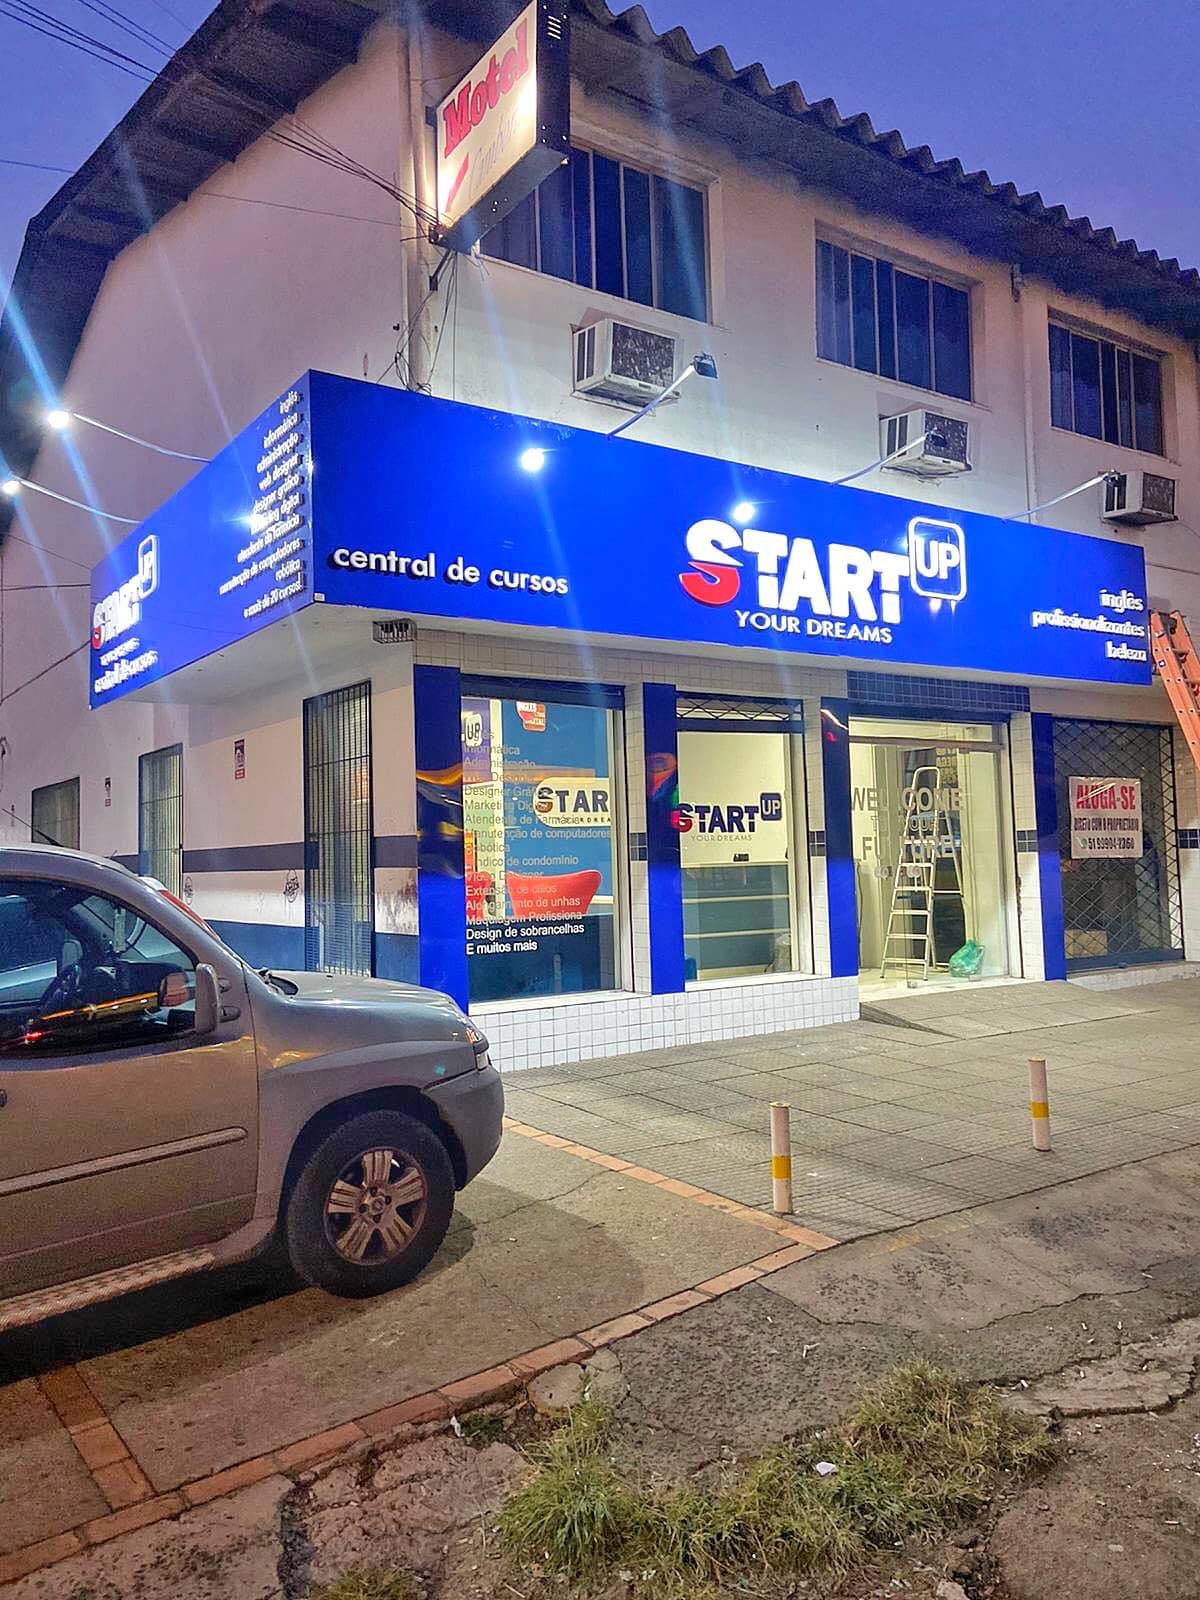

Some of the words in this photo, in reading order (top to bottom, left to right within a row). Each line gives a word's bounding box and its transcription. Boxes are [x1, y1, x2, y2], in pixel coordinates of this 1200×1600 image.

[443, 18, 529, 158] Motel
[264, 412, 298, 449] informática
[333, 548, 436, 577] central
[448, 557, 480, 583] de
[489, 569, 568, 594] cursos
[679, 519, 910, 625] START
[916, 540, 961, 580] UP
[1100, 589, 1144, 613] inglês
[735, 610, 801, 634] YOUR
[807, 618, 893, 643] DREAMS
[1106, 640, 1147, 661] beleza
[1076, 784, 1135, 809] ALUGA-SE
[520, 814, 532, 825] de
[671, 803, 758, 833] START
[762, 799, 781, 815] UP
[530, 828, 543, 839] de
[545, 828, 611, 841] computadores
[522, 855, 579, 867] condomínio
[536, 896, 547, 907] de
[552, 895, 580, 907] unhas
[466, 927, 502, 941] Design
[505, 926, 517, 938] de
[520, 923, 585, 937] sobrancelhas
[466, 943, 474, 955] E
[477, 941, 511, 954] muitos
[514, 940, 538, 952] mais
